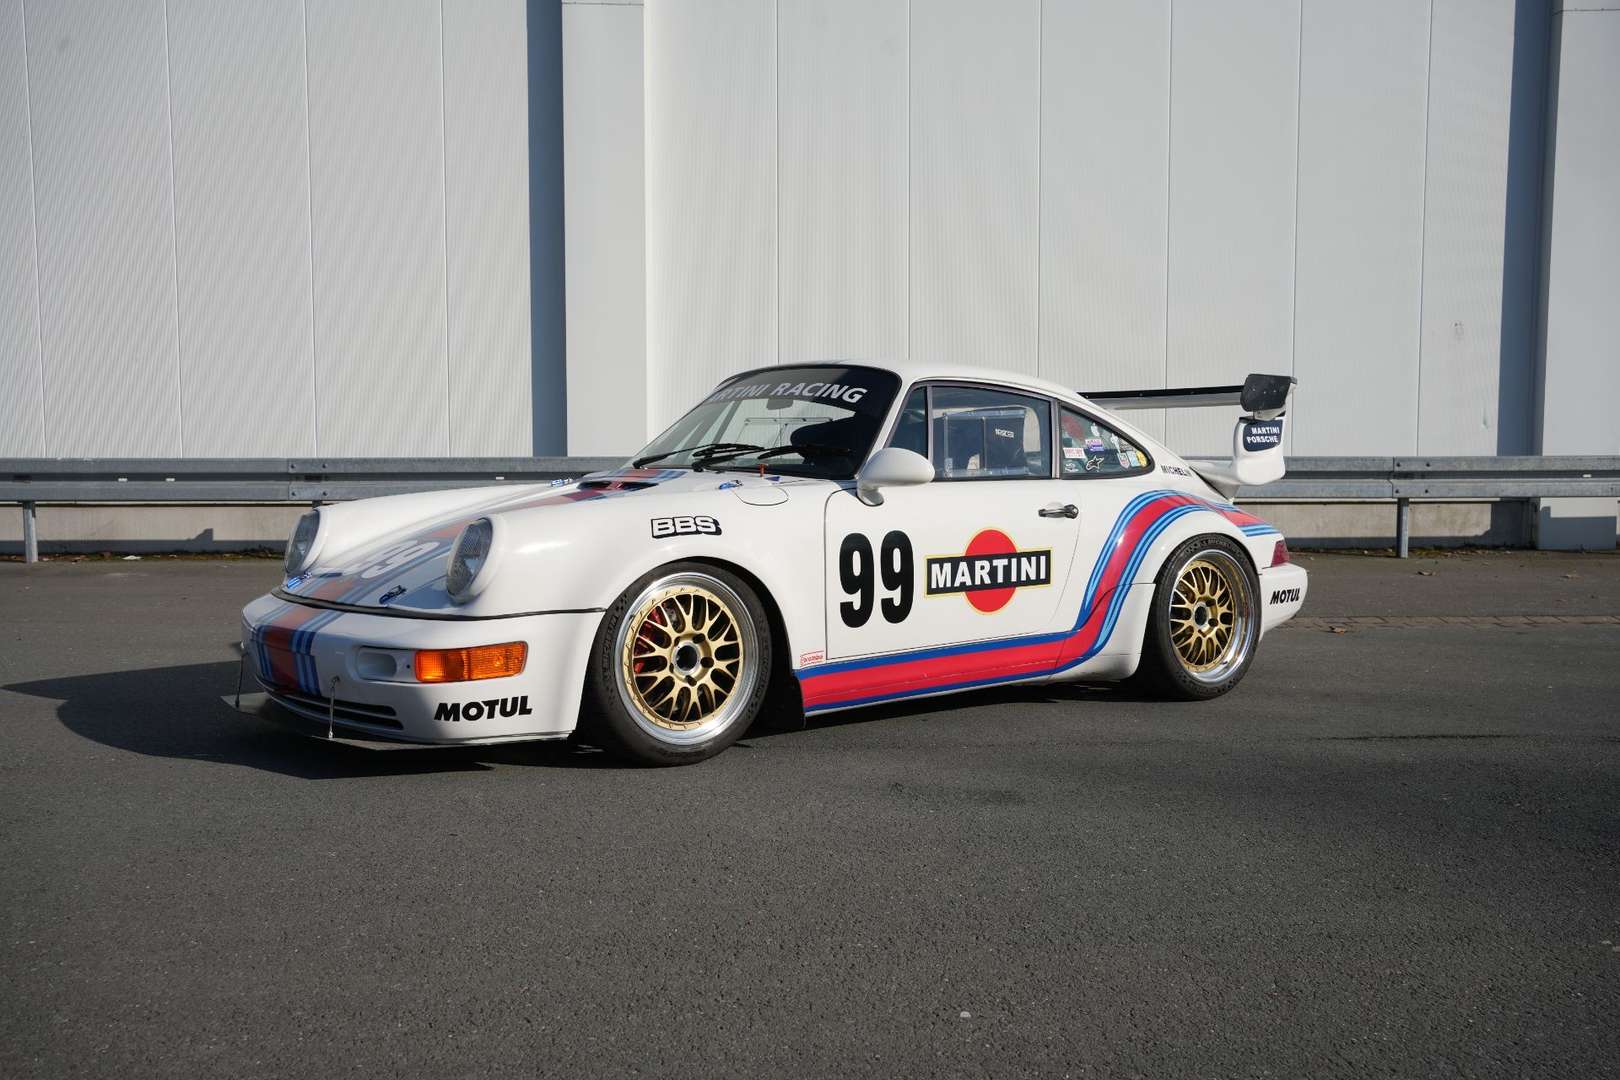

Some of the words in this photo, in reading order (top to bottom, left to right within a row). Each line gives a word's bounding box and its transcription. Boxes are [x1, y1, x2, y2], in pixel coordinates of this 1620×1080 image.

[770, 382, 868, 404] RACING
[1246, 435, 1279, 444] PORSCHE
[1251, 426, 1280, 435] MARTINI
[651, 515, 722, 539] BBS
[839, 530, 915, 629] 99
[930, 555, 1047, 589] MARTINI
[1269, 588, 1301, 605] MOTUL
[434, 695, 533, 722] MOTUL
